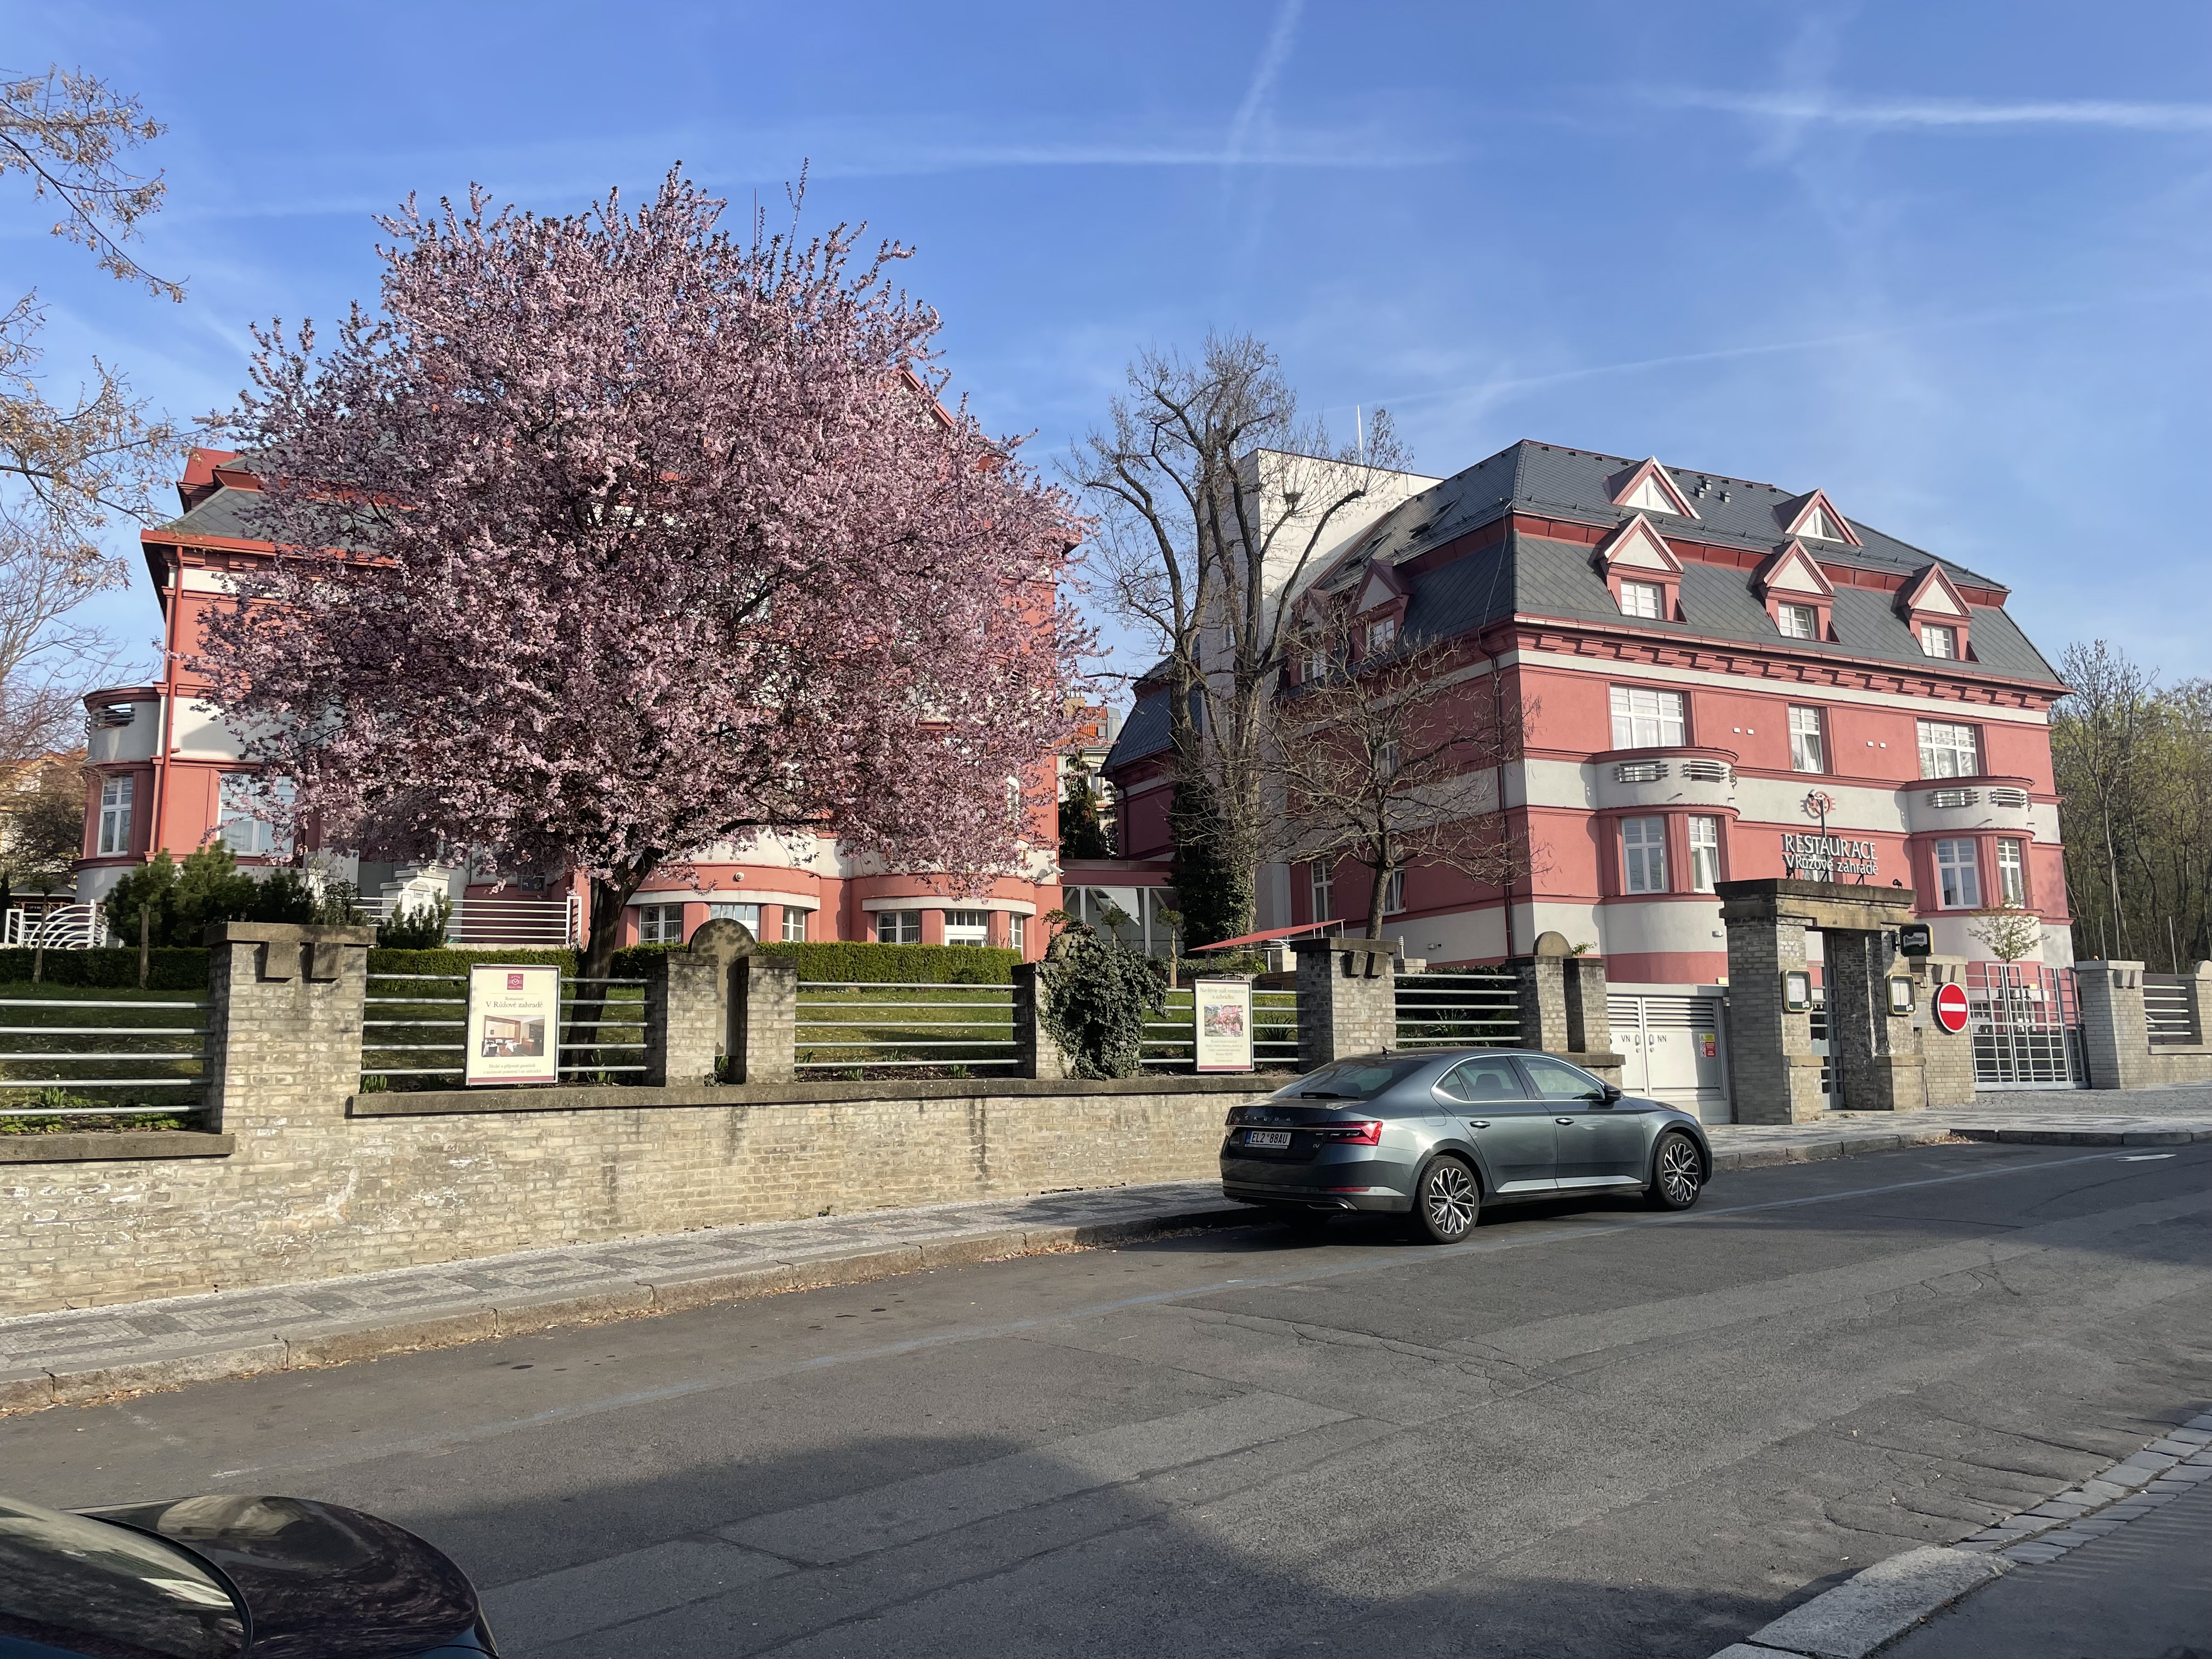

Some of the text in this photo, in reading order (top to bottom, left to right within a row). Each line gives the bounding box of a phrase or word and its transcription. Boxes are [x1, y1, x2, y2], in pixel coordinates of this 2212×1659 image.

[1784, 834, 1878, 860] RESTAURACE
[1785, 855, 1794, 868] V
[1838, 860, 1878, 875] zahradě
[1251, 1133, 1288, 1143] EL2 88AU
